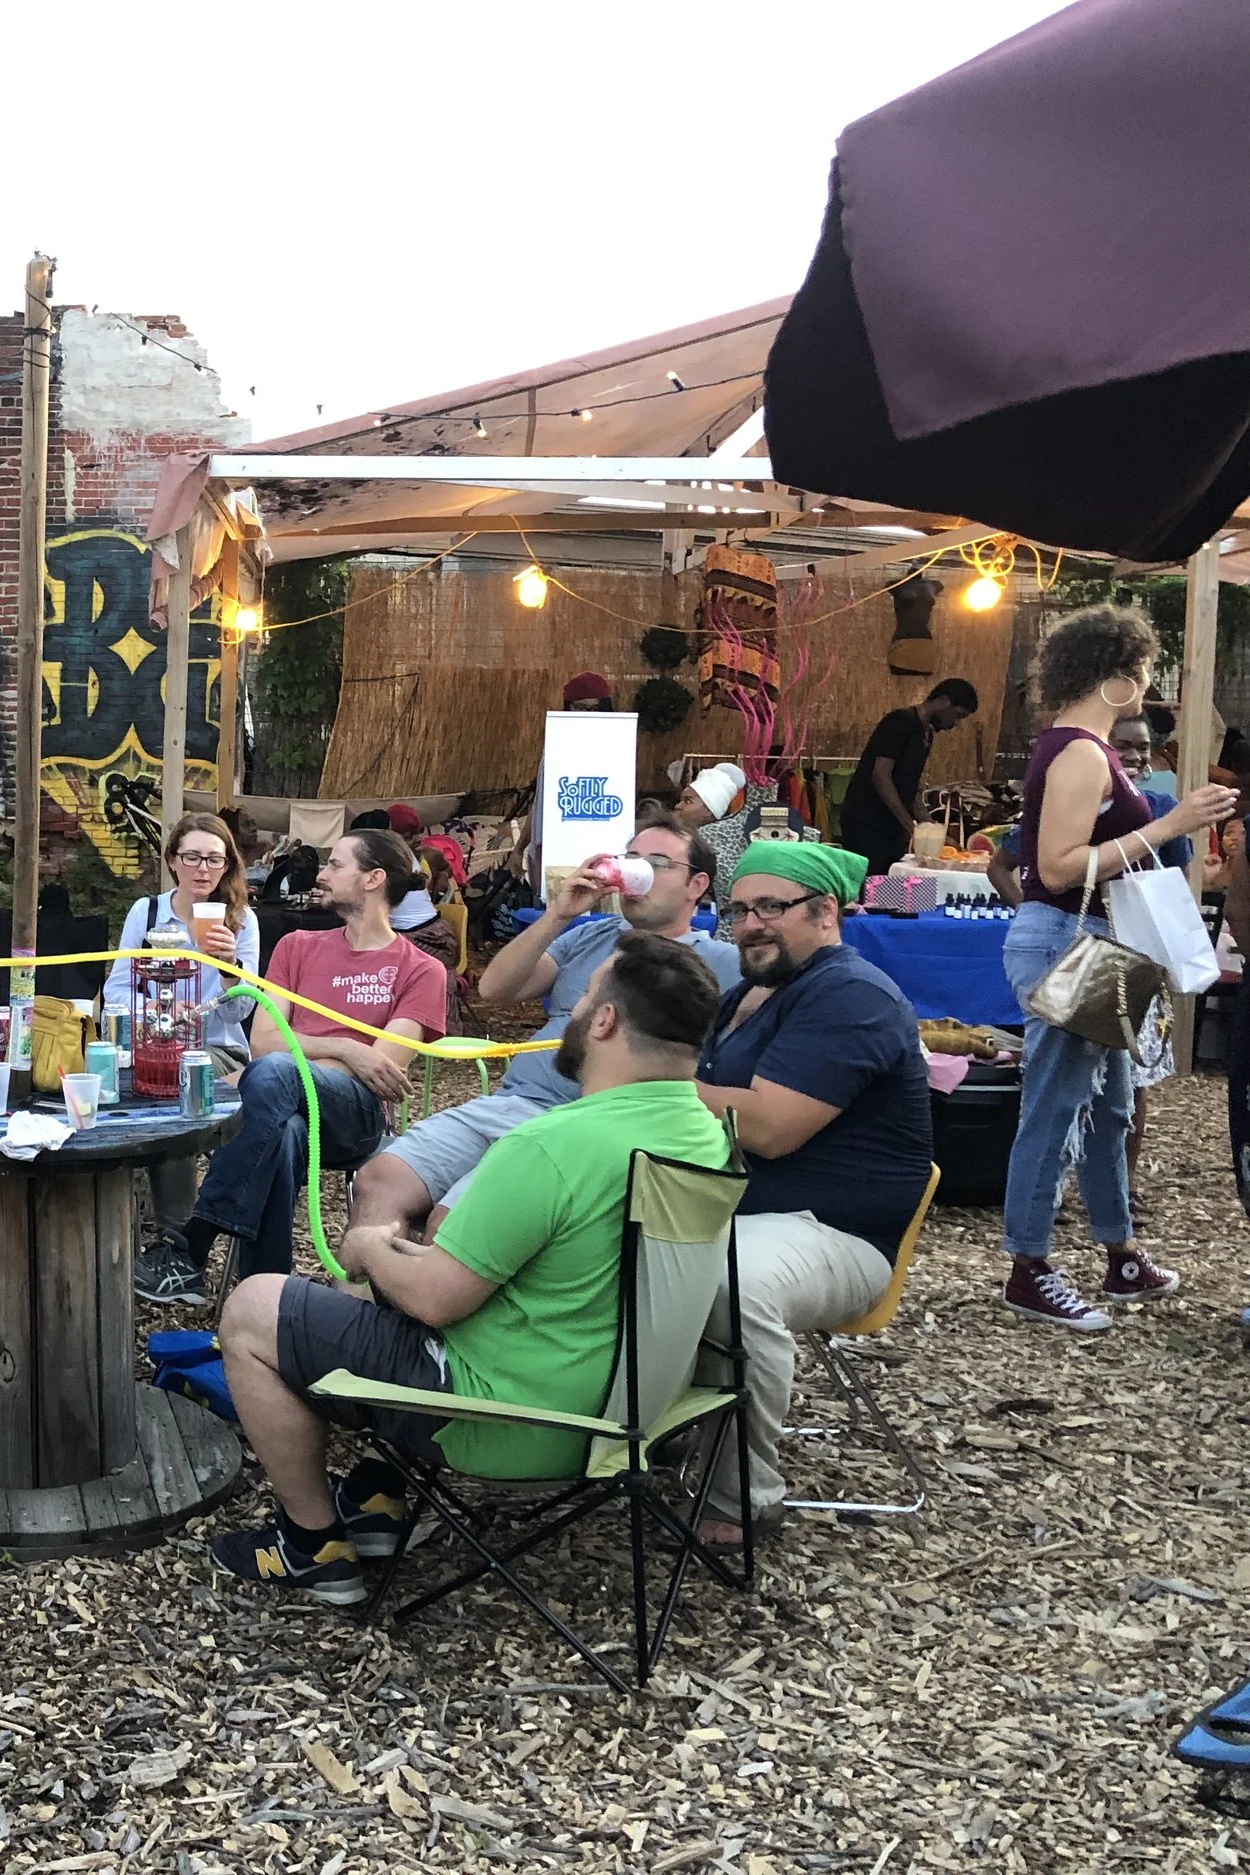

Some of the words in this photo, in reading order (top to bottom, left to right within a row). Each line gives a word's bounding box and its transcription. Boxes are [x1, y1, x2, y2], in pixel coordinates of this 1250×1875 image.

[558, 795, 623, 817] RUGGED
[332, 971, 378, 987] #make
[351, 983, 393, 994] better
[255, 1546, 287, 1579] N
